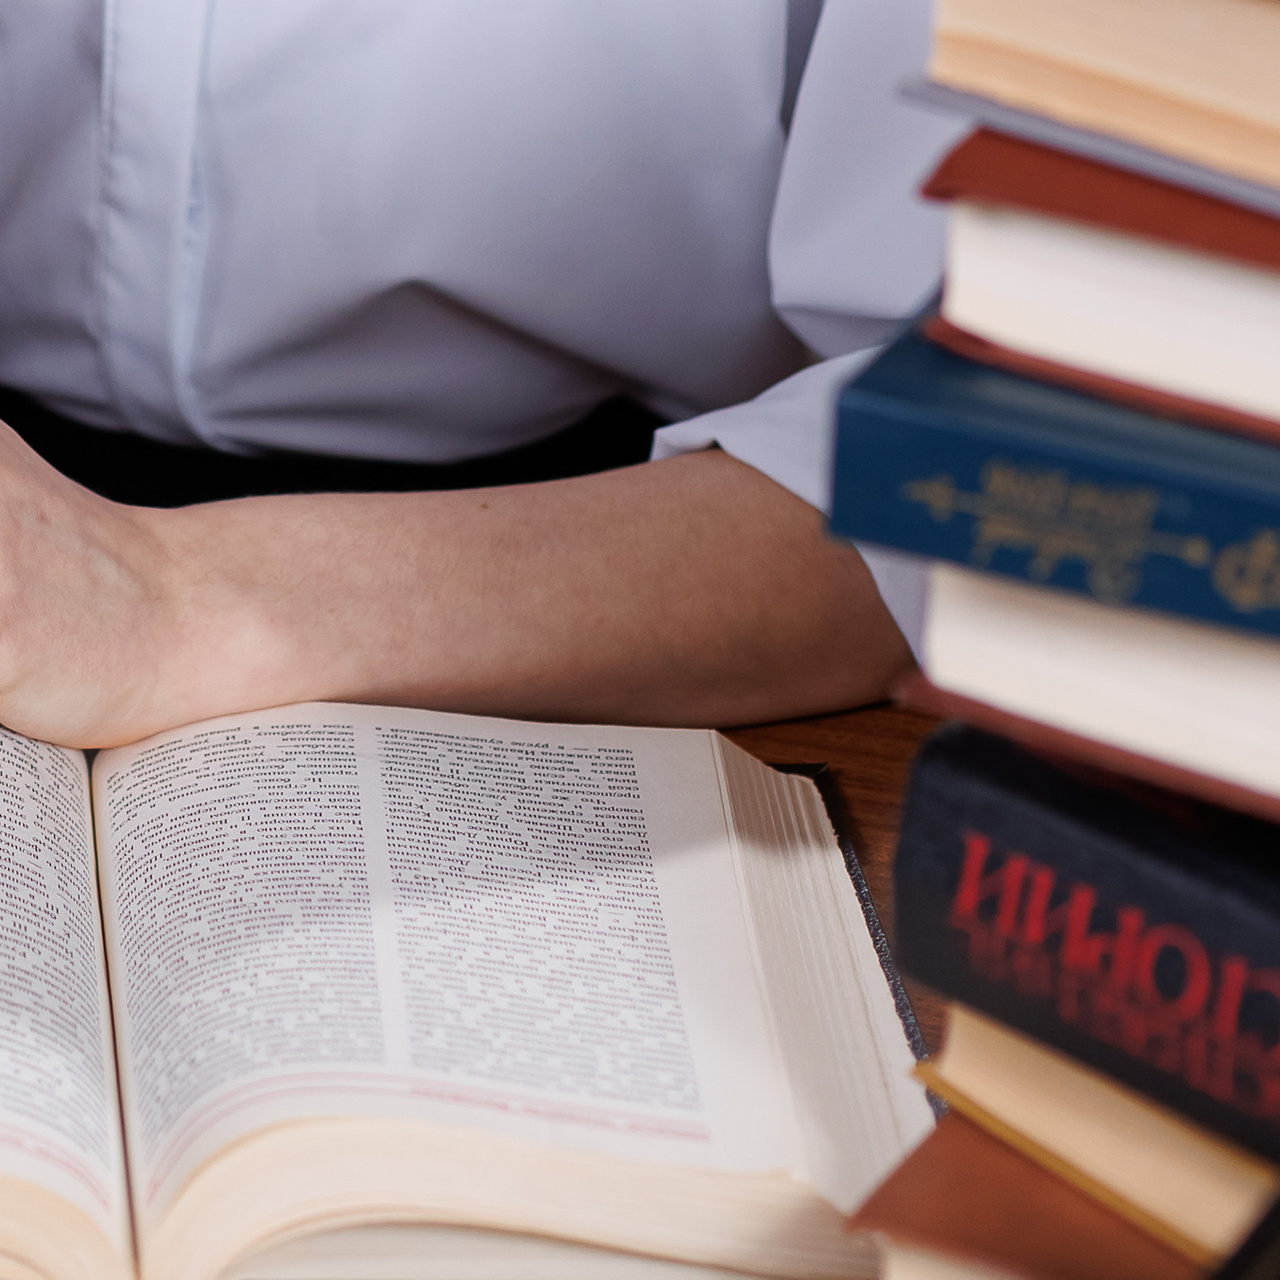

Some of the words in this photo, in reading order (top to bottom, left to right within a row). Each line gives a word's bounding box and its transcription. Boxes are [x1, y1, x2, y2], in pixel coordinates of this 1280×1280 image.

[15, 770, 23, 778] и
[2, 798, 24, 811] для
[180, 793, 256, 812] содействие
[224, 797, 320, 809] православной
[383, 801, 424, 810] Крас-
[437, 800, 498, 813] читатель
[6, 808, 26, 820] это
[36, 814, 44, 822] и
[170, 806, 217, 823] церкви
[210, 808, 250, 819] целом
[435, 806, 500, 821] Дмитрий
[506, 810, 605, 828] Познакомится
[245, 819, 306, 827] говорить
[448, 815, 509, 829] Василий
[467, 825, 522, 837] великое
[527, 827, 585, 839] сыновья
[584, 827, 648, 838] Дмитрий
[161, 830, 208, 849] полной
[486, 835, 529, 847] Юрий
[557, 838, 650, 852] притязавший
[538, 843, 578, 852] князь
[586, 849, 652, 860] галицкий
